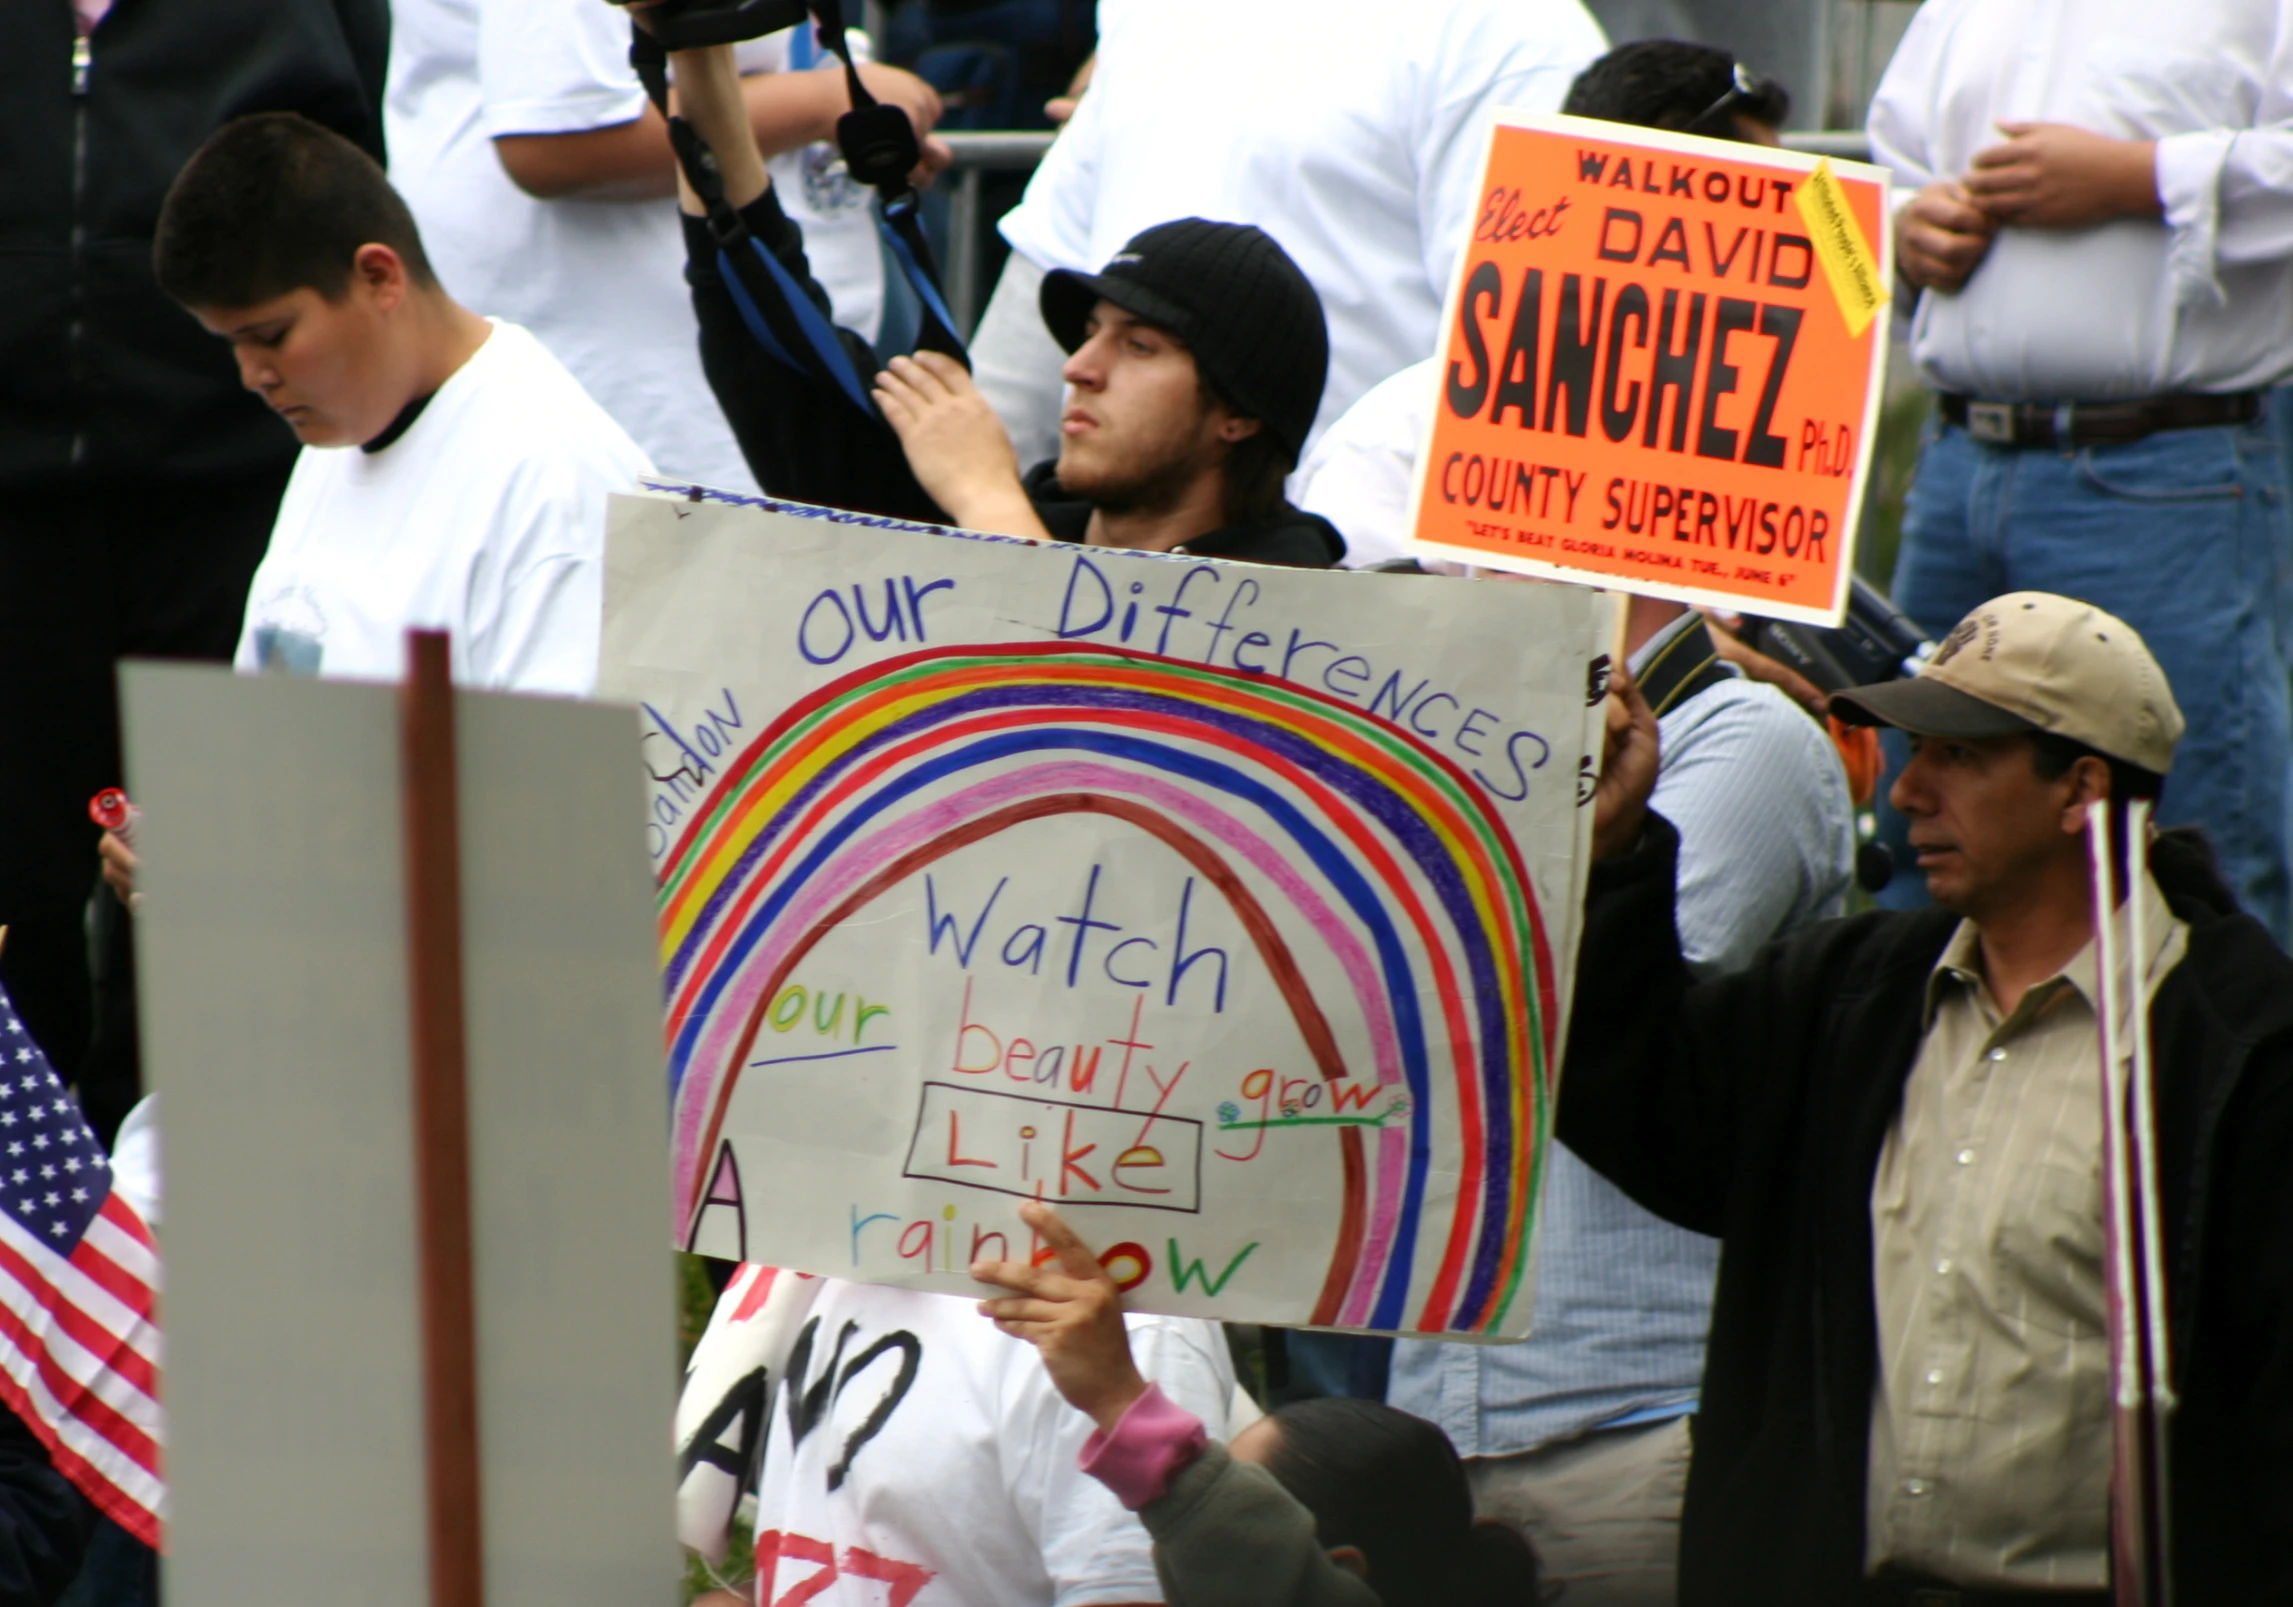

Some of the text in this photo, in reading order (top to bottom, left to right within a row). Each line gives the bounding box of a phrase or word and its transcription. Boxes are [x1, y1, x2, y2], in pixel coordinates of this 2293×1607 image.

[1475, 187, 1571, 242] Elect
[1576, 150, 1793, 213] WALKOUT
[1597, 207, 1814, 290] DAVID
[1447, 261, 1853, 479] SANCHEZ Ph.D.
[1443, 452, 1829, 564] COUNTY SUPERVISOR
[1517, 530, 1555, 548] BEAT
[1561, 538, 1616, 558] GLORIA
[1733, 567, 1770, 585] JUNE
[926, 864, 1228, 1014] Watch
[767, 976, 1382, 1161] our beauty grow
[687, 1138, 747, 1262] A
[947, 1110, 1172, 1196] Like
